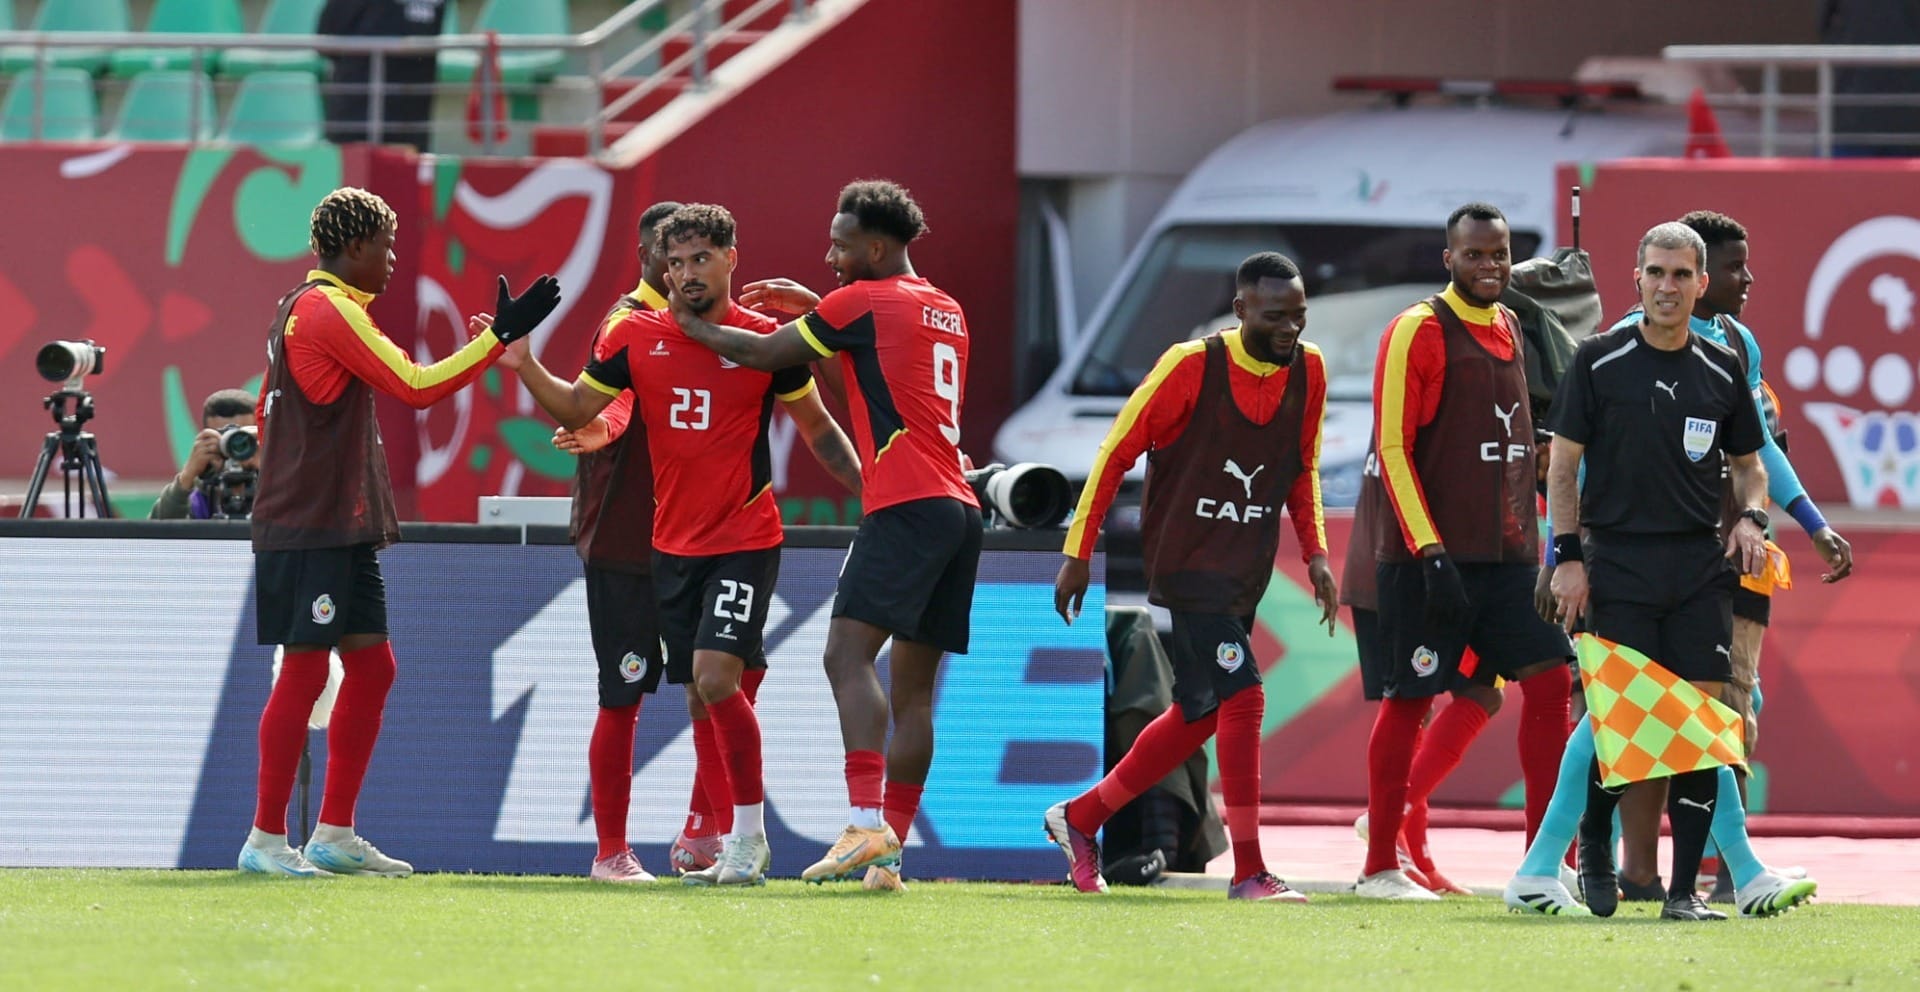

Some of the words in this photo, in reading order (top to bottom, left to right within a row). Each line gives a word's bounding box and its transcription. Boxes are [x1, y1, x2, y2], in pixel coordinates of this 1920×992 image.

[922, 306, 965, 337] FAIZAL
[670, 387, 711, 430] 23
[933, 342, 960, 446] 9
[1688, 421, 1712, 434] FIFA
[1196, 498, 1263, 523] CAF
[714, 580, 754, 623] 23
